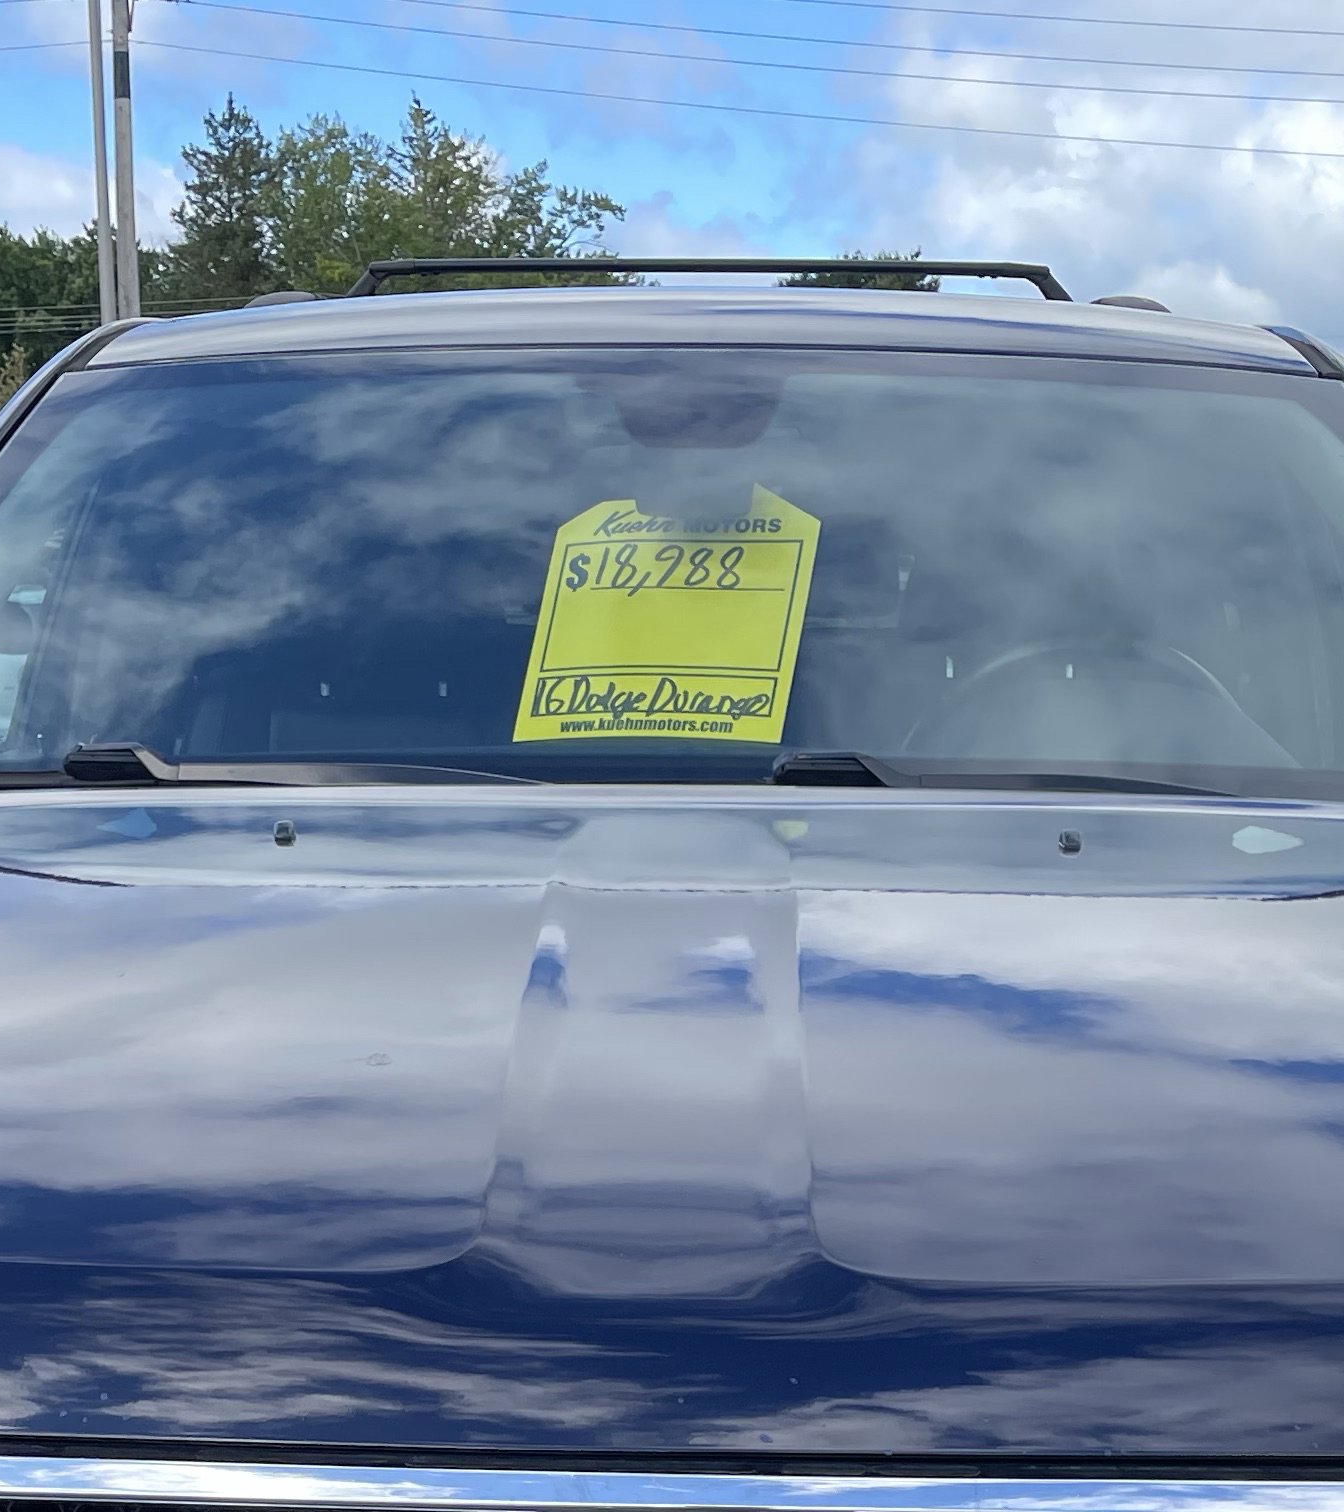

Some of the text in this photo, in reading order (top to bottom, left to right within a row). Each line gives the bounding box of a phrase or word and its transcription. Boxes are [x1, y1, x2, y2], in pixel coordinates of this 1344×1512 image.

[593, 509, 783, 538] Kuehn MOTORS
[566, 675, 648, 721] Dodge
[645, 676, 771, 721] Durango
[560, 716, 734, 734] www.kuehnmotors.com
